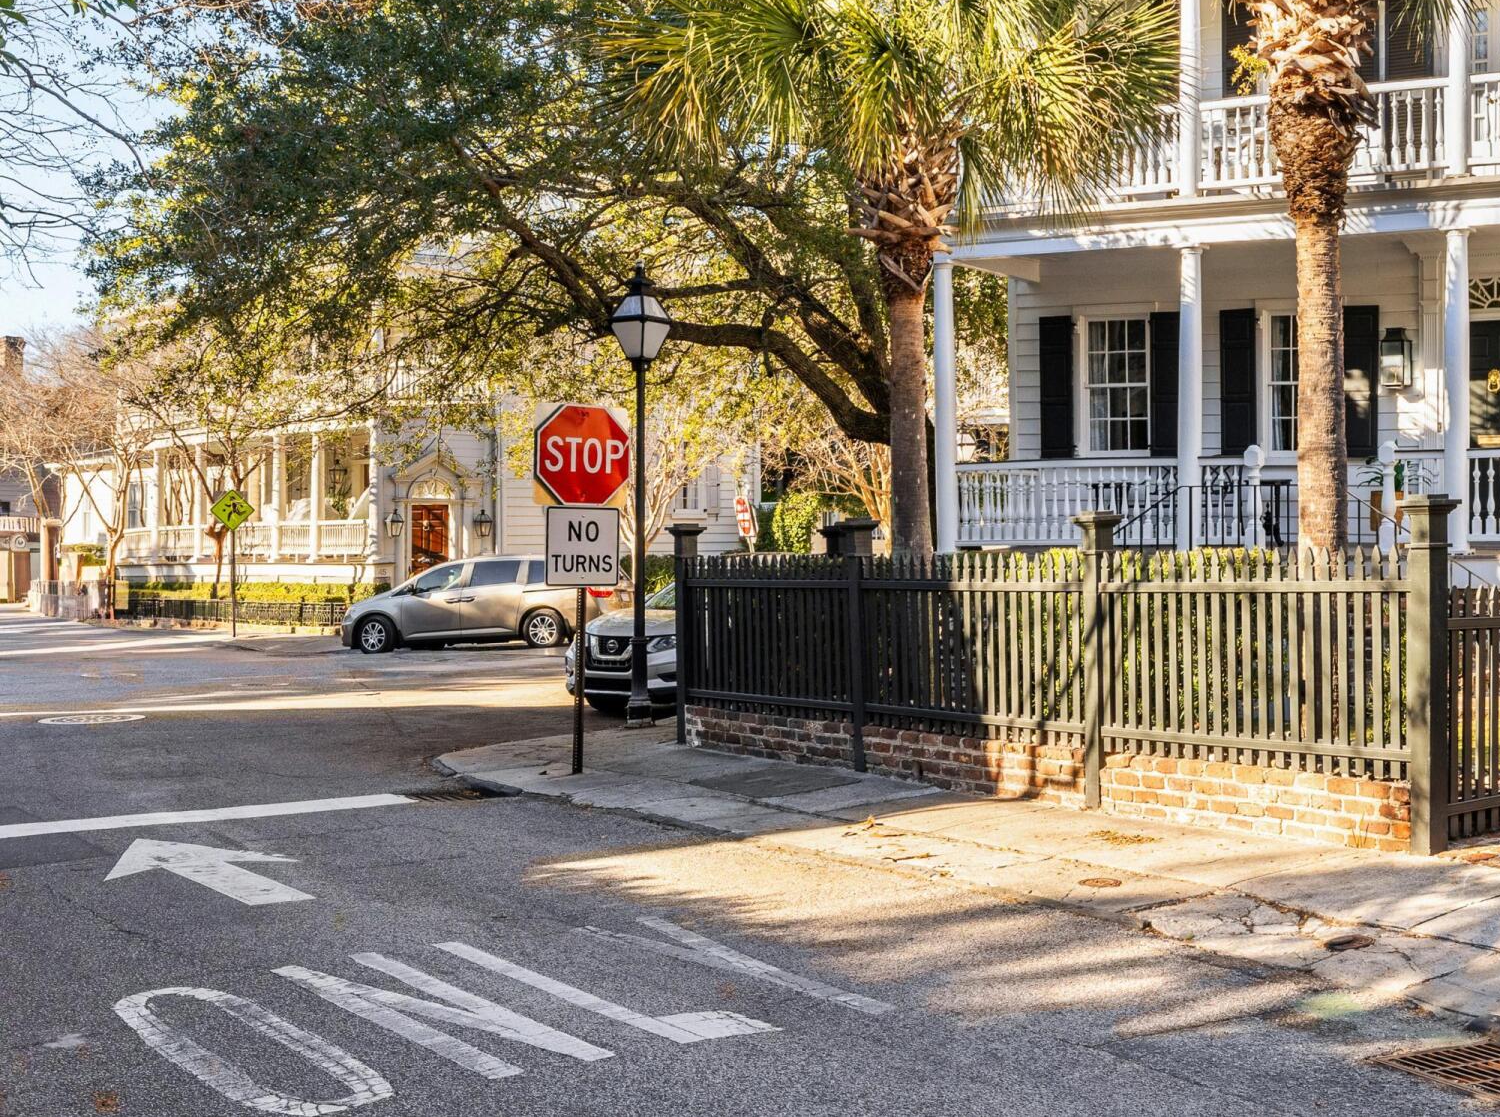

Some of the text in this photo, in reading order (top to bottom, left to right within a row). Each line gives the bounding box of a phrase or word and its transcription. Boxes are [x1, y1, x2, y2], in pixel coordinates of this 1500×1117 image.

[544, 435, 624, 474] STOP
[567, 520, 599, 542] NO
[551, 554, 613, 573] TURNS
[113, 917, 895, 1116] ONLY
